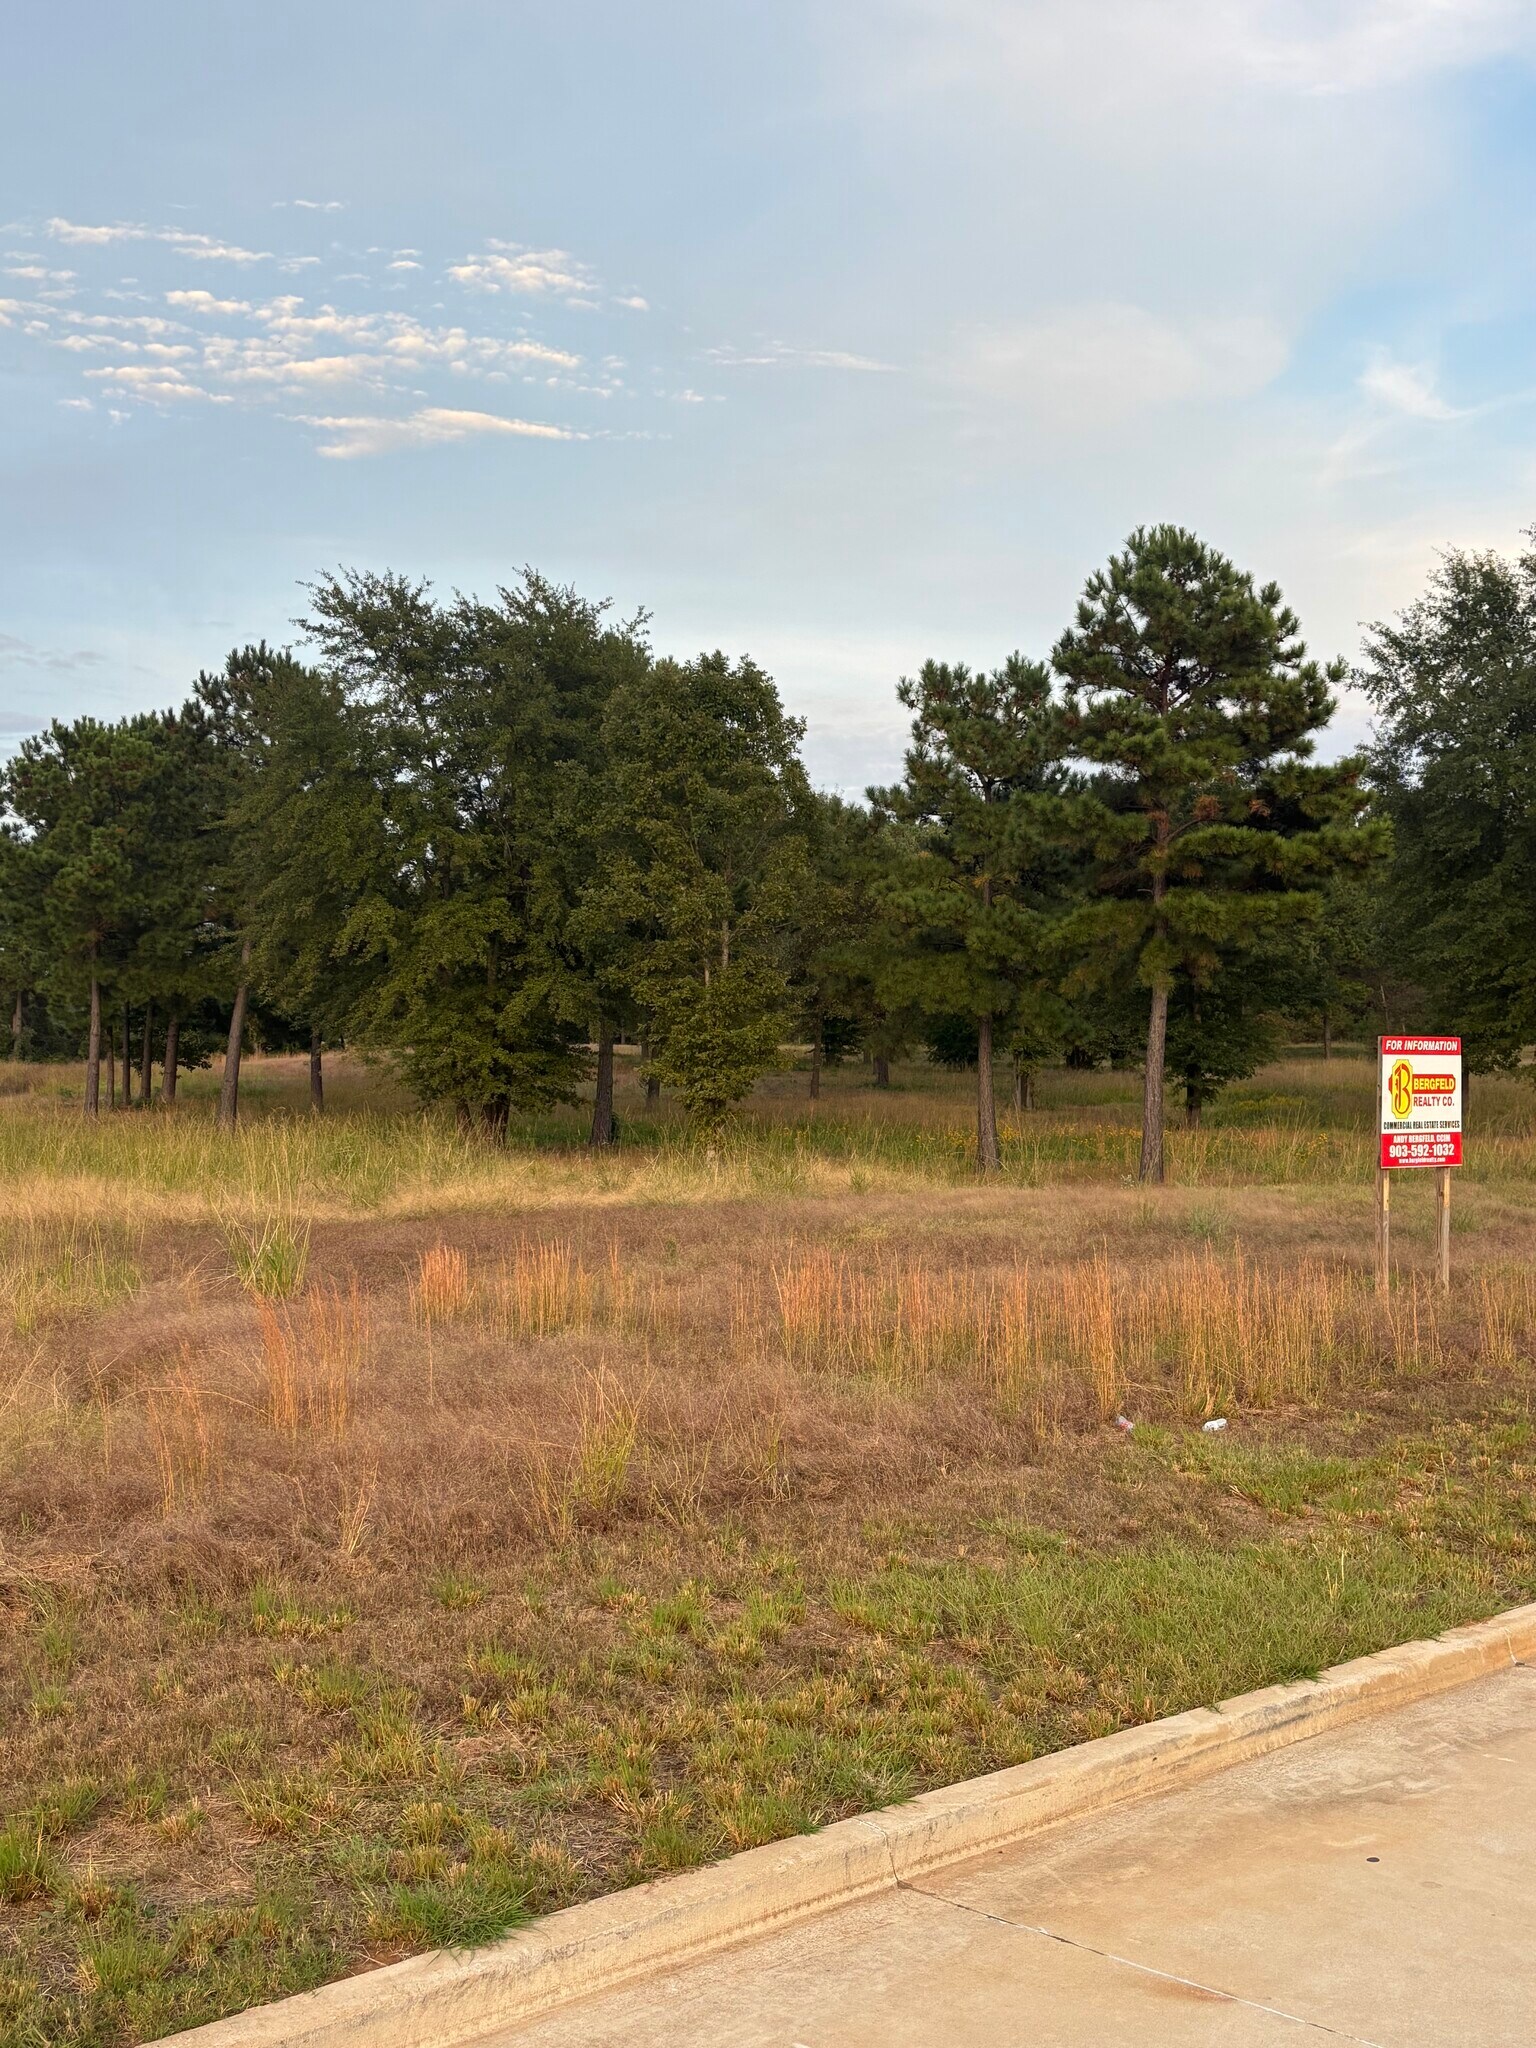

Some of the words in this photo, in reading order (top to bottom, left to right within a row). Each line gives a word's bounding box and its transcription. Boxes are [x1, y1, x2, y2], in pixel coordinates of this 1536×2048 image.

[1386, 1040, 1402, 1050] FOR
[1404, 1040, 1458, 1051] INFORMATION
[1413, 1078, 1455, 1090] BERGFELD
[1413, 1096, 1440, 1107] REALTY
[1442, 1096, 1455, 1107] CO.
[1383, 1121, 1412, 1130] COMMERCIAL
[1413, 1121, 1423, 1129] REAL
[1424, 1121, 1439, 1129] ESTATE
[1440, 1120, 1460, 1129] SERVICES
[1393, 1135, 1408, 1143] ANDY
[1389, 1143, 1455, 1158] 903-592-1032
